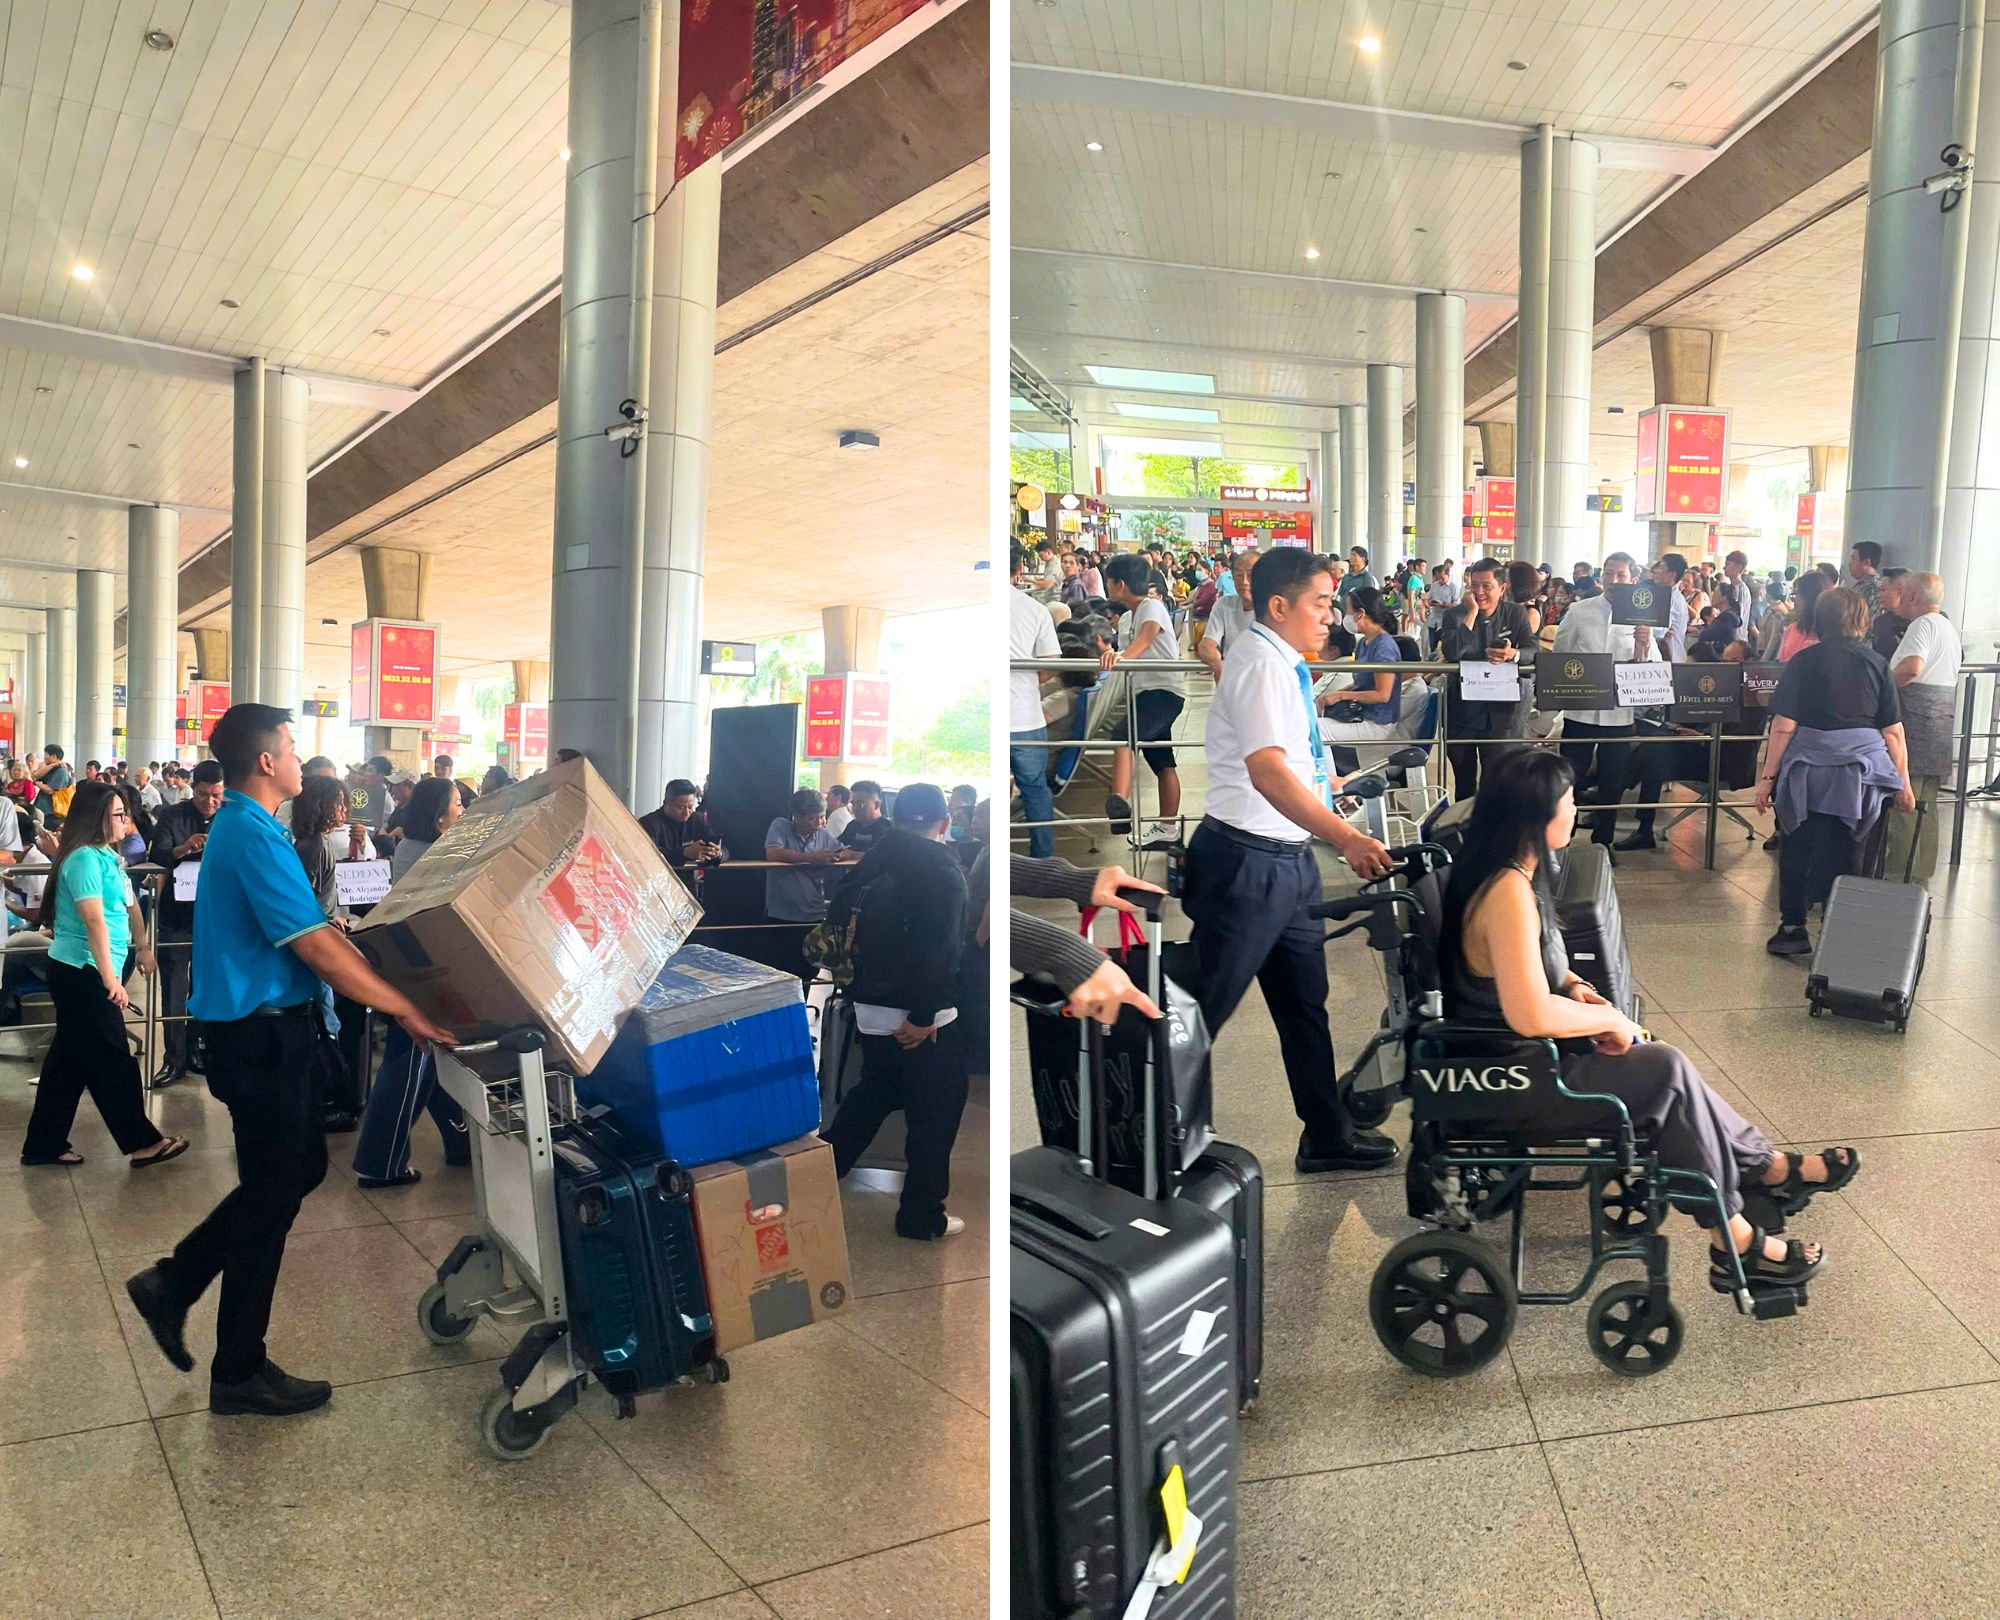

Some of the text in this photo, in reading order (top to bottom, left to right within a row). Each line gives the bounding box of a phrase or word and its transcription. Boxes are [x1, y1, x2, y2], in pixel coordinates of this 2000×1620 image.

[1602, 496, 1612, 510] 7
[1473, 517, 1480, 527] 6
[1748, 679, 1780, 688] SILVERLA
[319, 702, 328, 715] 7
[187, 719, 195, 729] 6
[349, 895, 384, 903] Rodrigue
[1418, 1065, 1531, 1093] VIAGS
